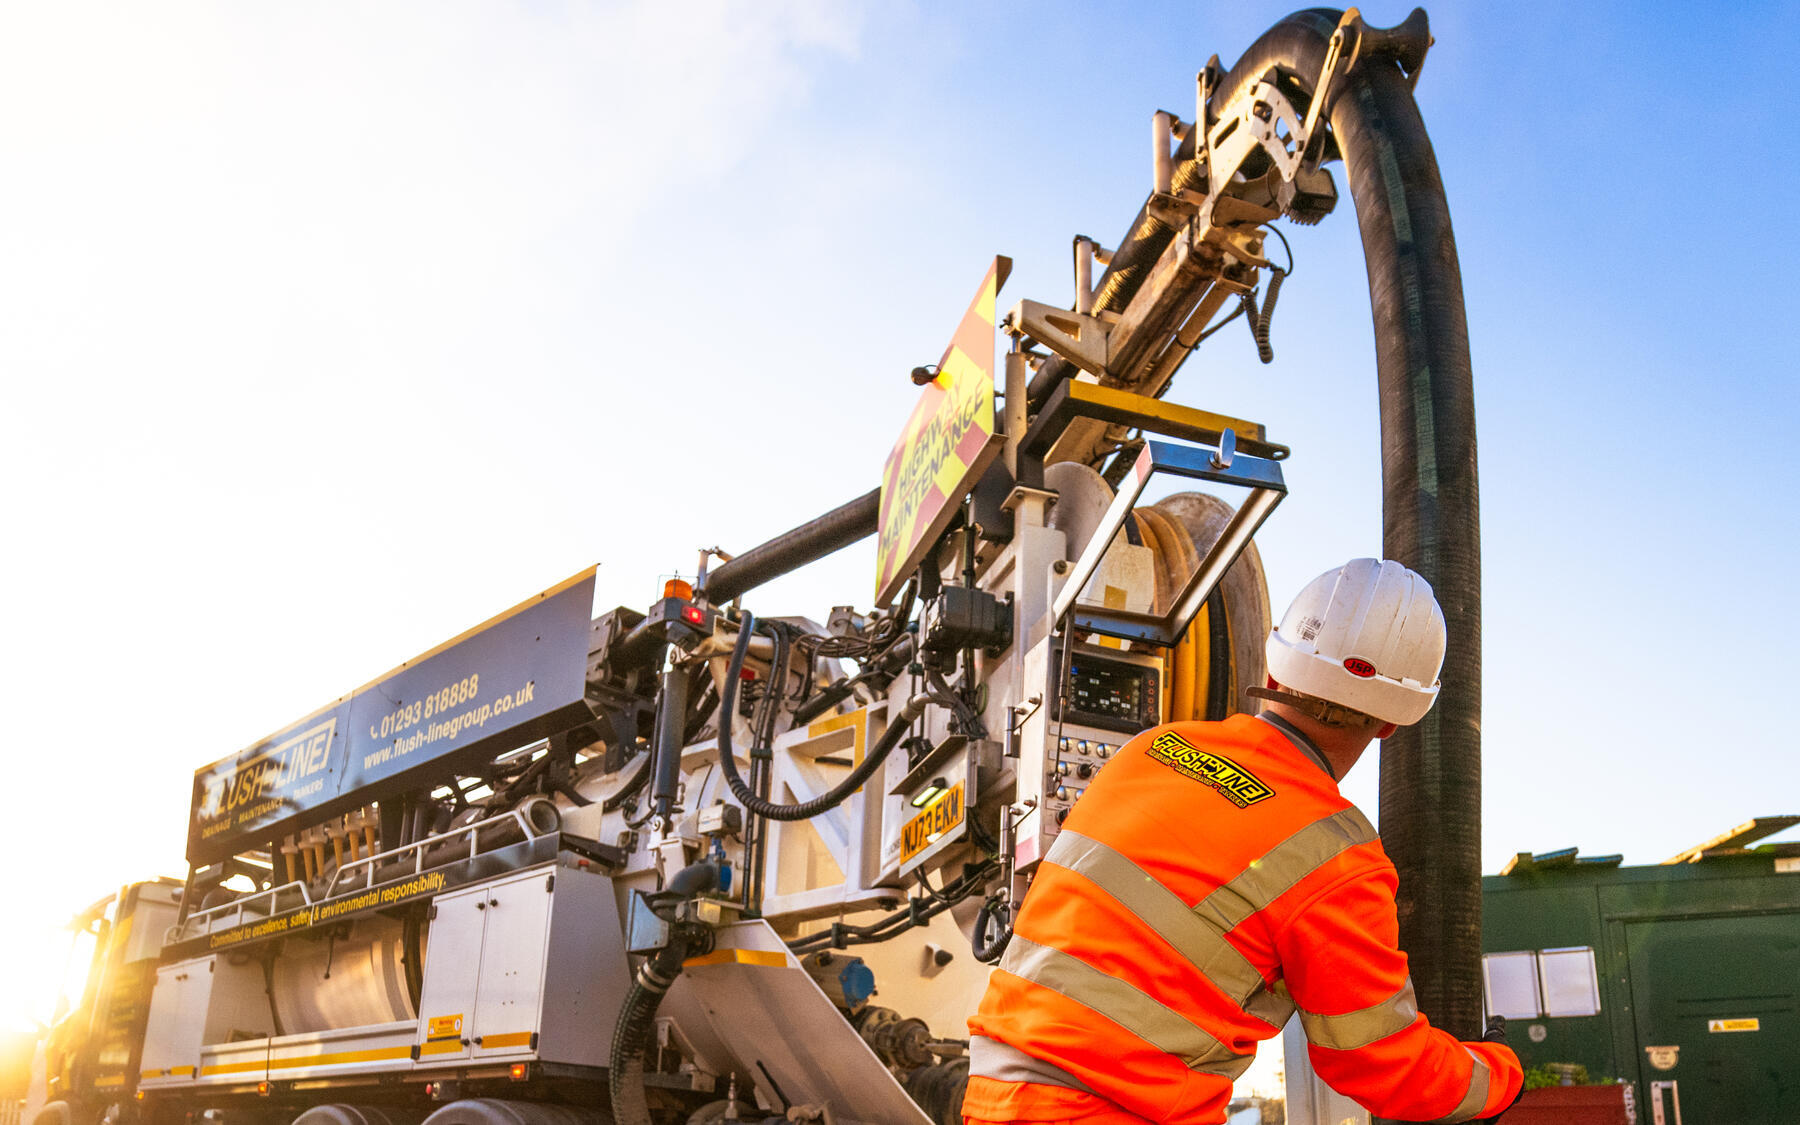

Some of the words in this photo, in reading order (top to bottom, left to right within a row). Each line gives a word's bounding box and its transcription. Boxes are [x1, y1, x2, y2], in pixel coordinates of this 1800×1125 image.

[881, 382, 984, 560] MAINTENANCE
[1348, 661, 1372, 674] JSP
[364, 681, 535, 770] www.flush-linegroup.co.uk
[381, 701, 422, 738] 01293
[424, 673, 479, 719] 818888
[239, 797, 284, 824] MAINTENANCE
[904, 811, 933, 857] NJ73
[935, 789, 959, 833] EKM
[210, 926, 244, 949] Committed
[244, 926, 252, 939] to
[321, 888, 380, 919] environmental
[381, 872, 447, 904] responsibility.
